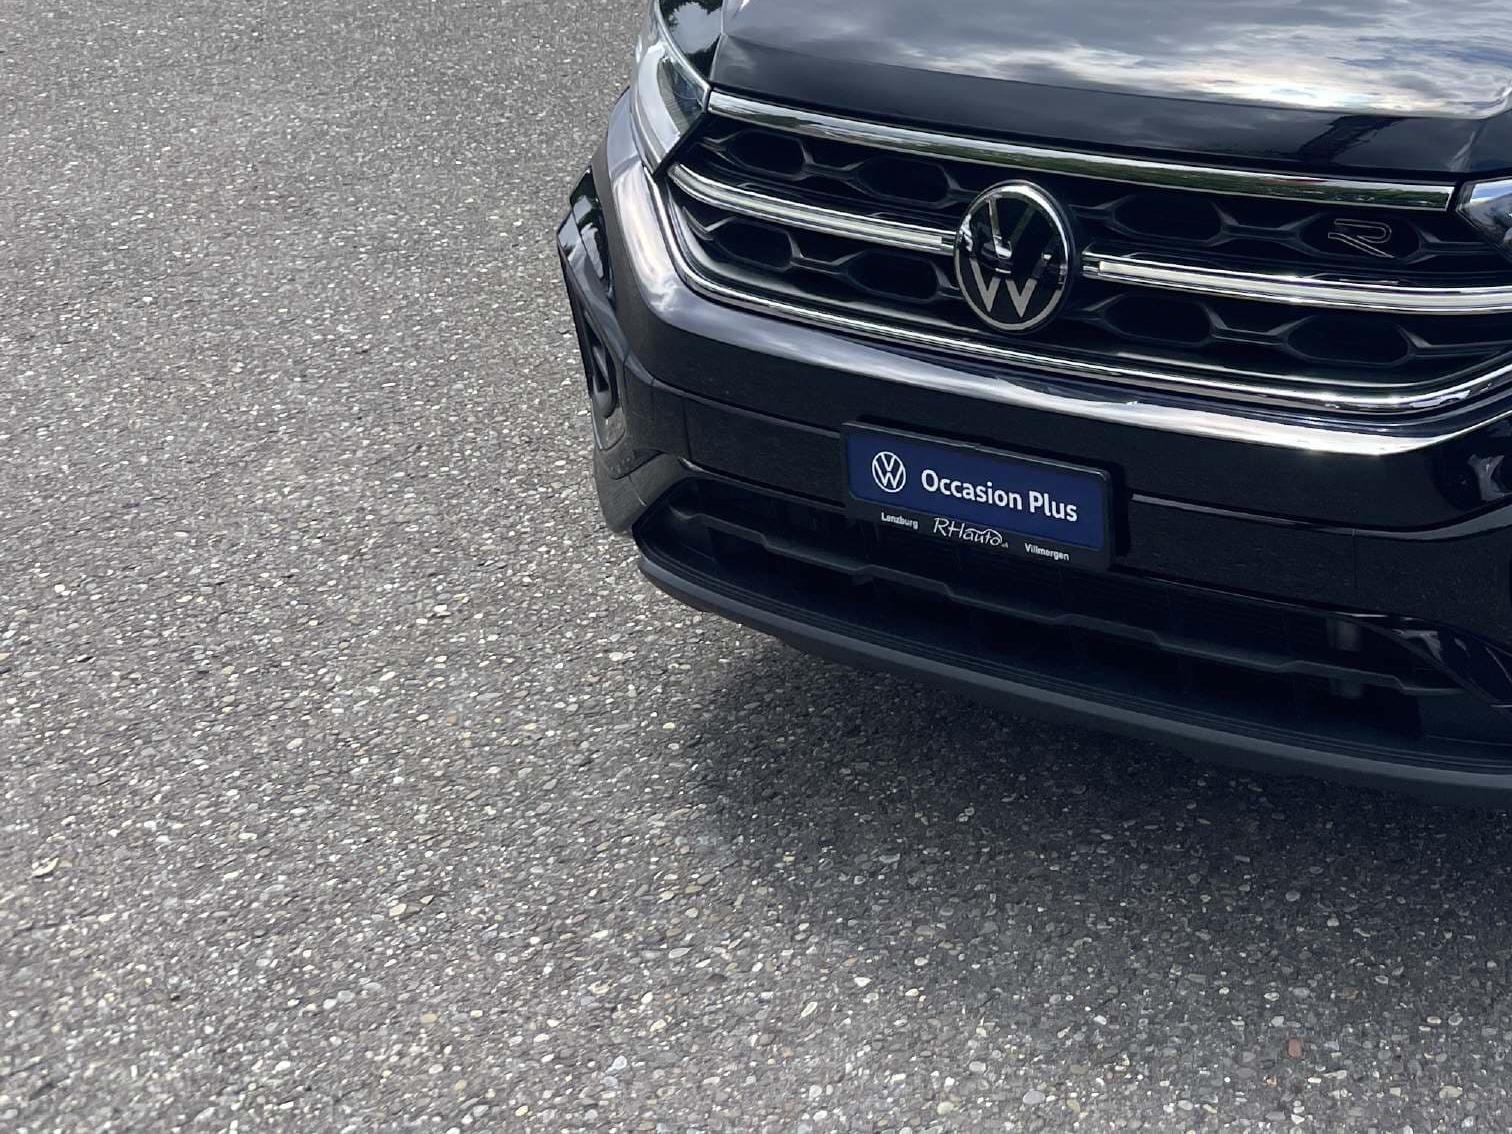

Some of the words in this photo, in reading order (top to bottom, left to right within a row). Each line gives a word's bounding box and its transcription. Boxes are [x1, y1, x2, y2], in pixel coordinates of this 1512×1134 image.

[921, 469, 1023, 511] Occasion
[1028, 491, 1078, 522] Plus
[881, 512, 919, 529] Lenzburg
[1025, 543, 1070, 561] Villmergen
